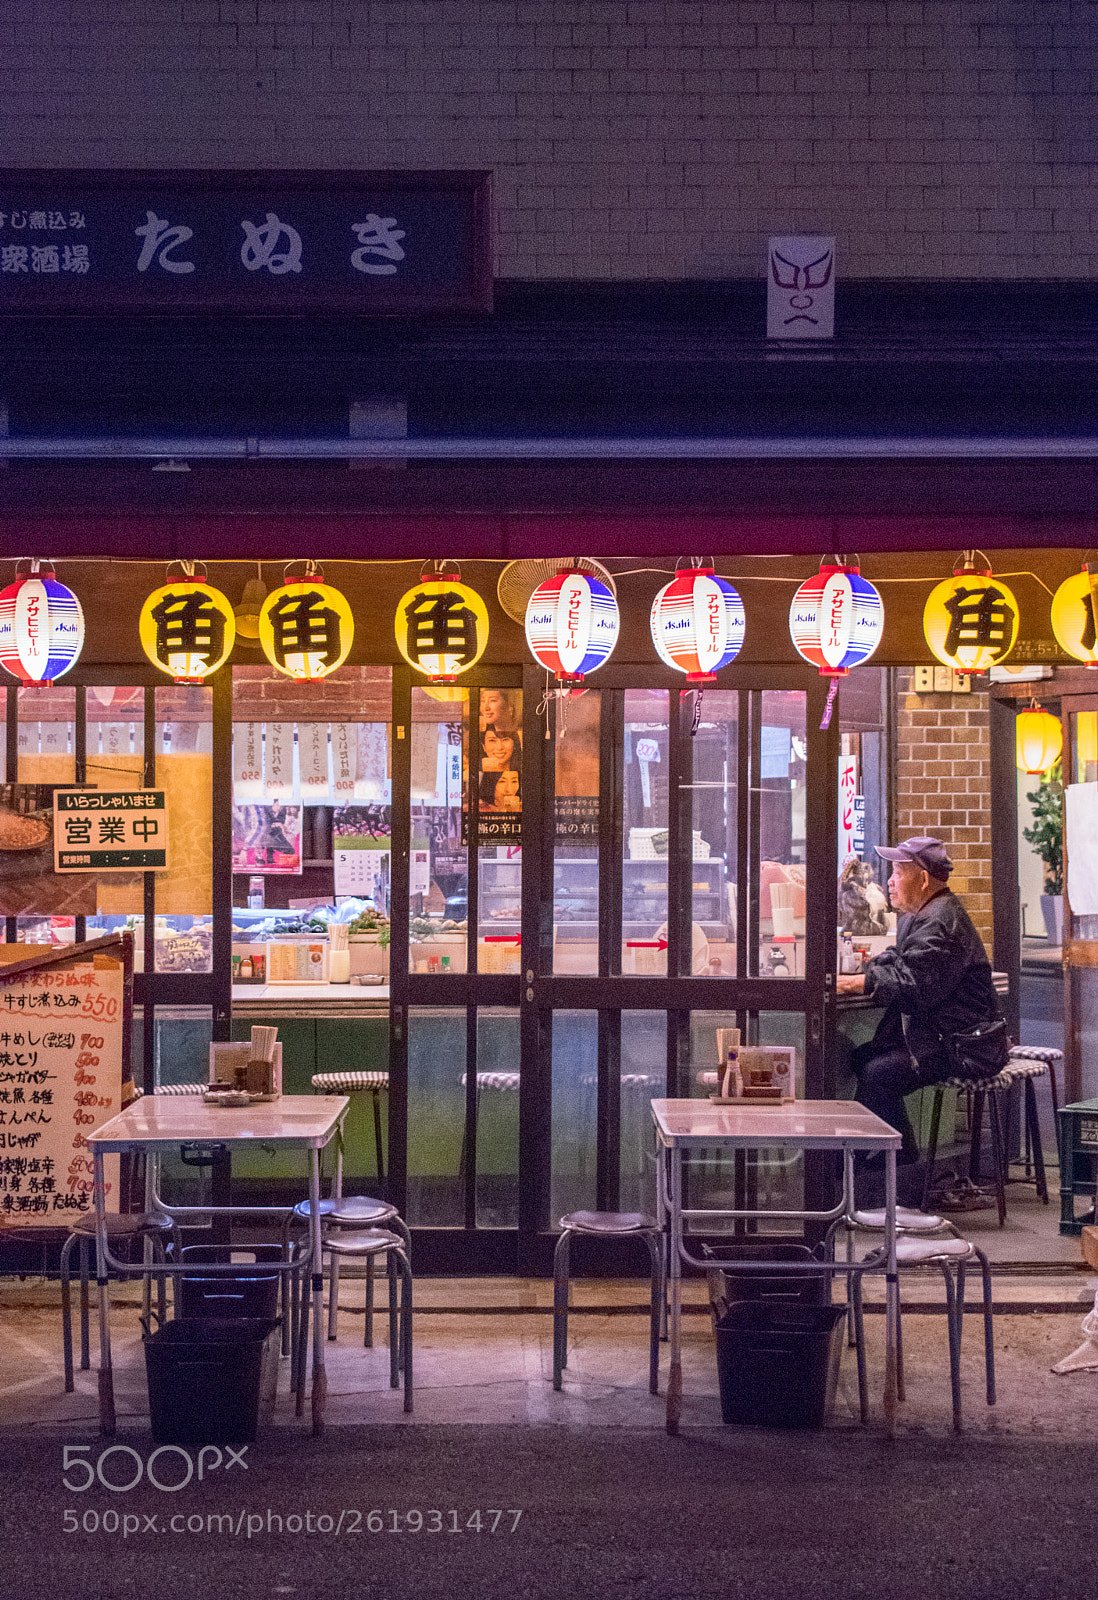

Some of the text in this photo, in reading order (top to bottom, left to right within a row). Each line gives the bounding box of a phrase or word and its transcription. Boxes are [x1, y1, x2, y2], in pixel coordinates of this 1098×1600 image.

[134, 210, 406, 275] たぬき
[26, 596, 40, 656] アサヒビール
[55, 622, 78, 633] Asahi
[530, 614, 553, 625] Asahi
[565, 590, 582, 649] アサヒビール
[665, 618, 690, 630] Asahi
[705, 594, 720, 652] アサヒビール
[795, 613, 816, 622] Asahi
[827, 588, 845, 647] アサヒビール
[66, 795, 156, 808] いらっしゃいませ
[65, 816, 159, 844] 営業中
[4, 992, 118, 1017] 牛すじ煮込み 550
[0, 1030, 41, 1047] 牛めし
[80, 1033, 104, 1050] 700
[75, 1052, 100, 1068] 500
[28, 1089, 54, 1105] 各種
[72, 1132, 91, 1149] 50
[0, 1190, 91, 1214] 衆酒場 たぬき
